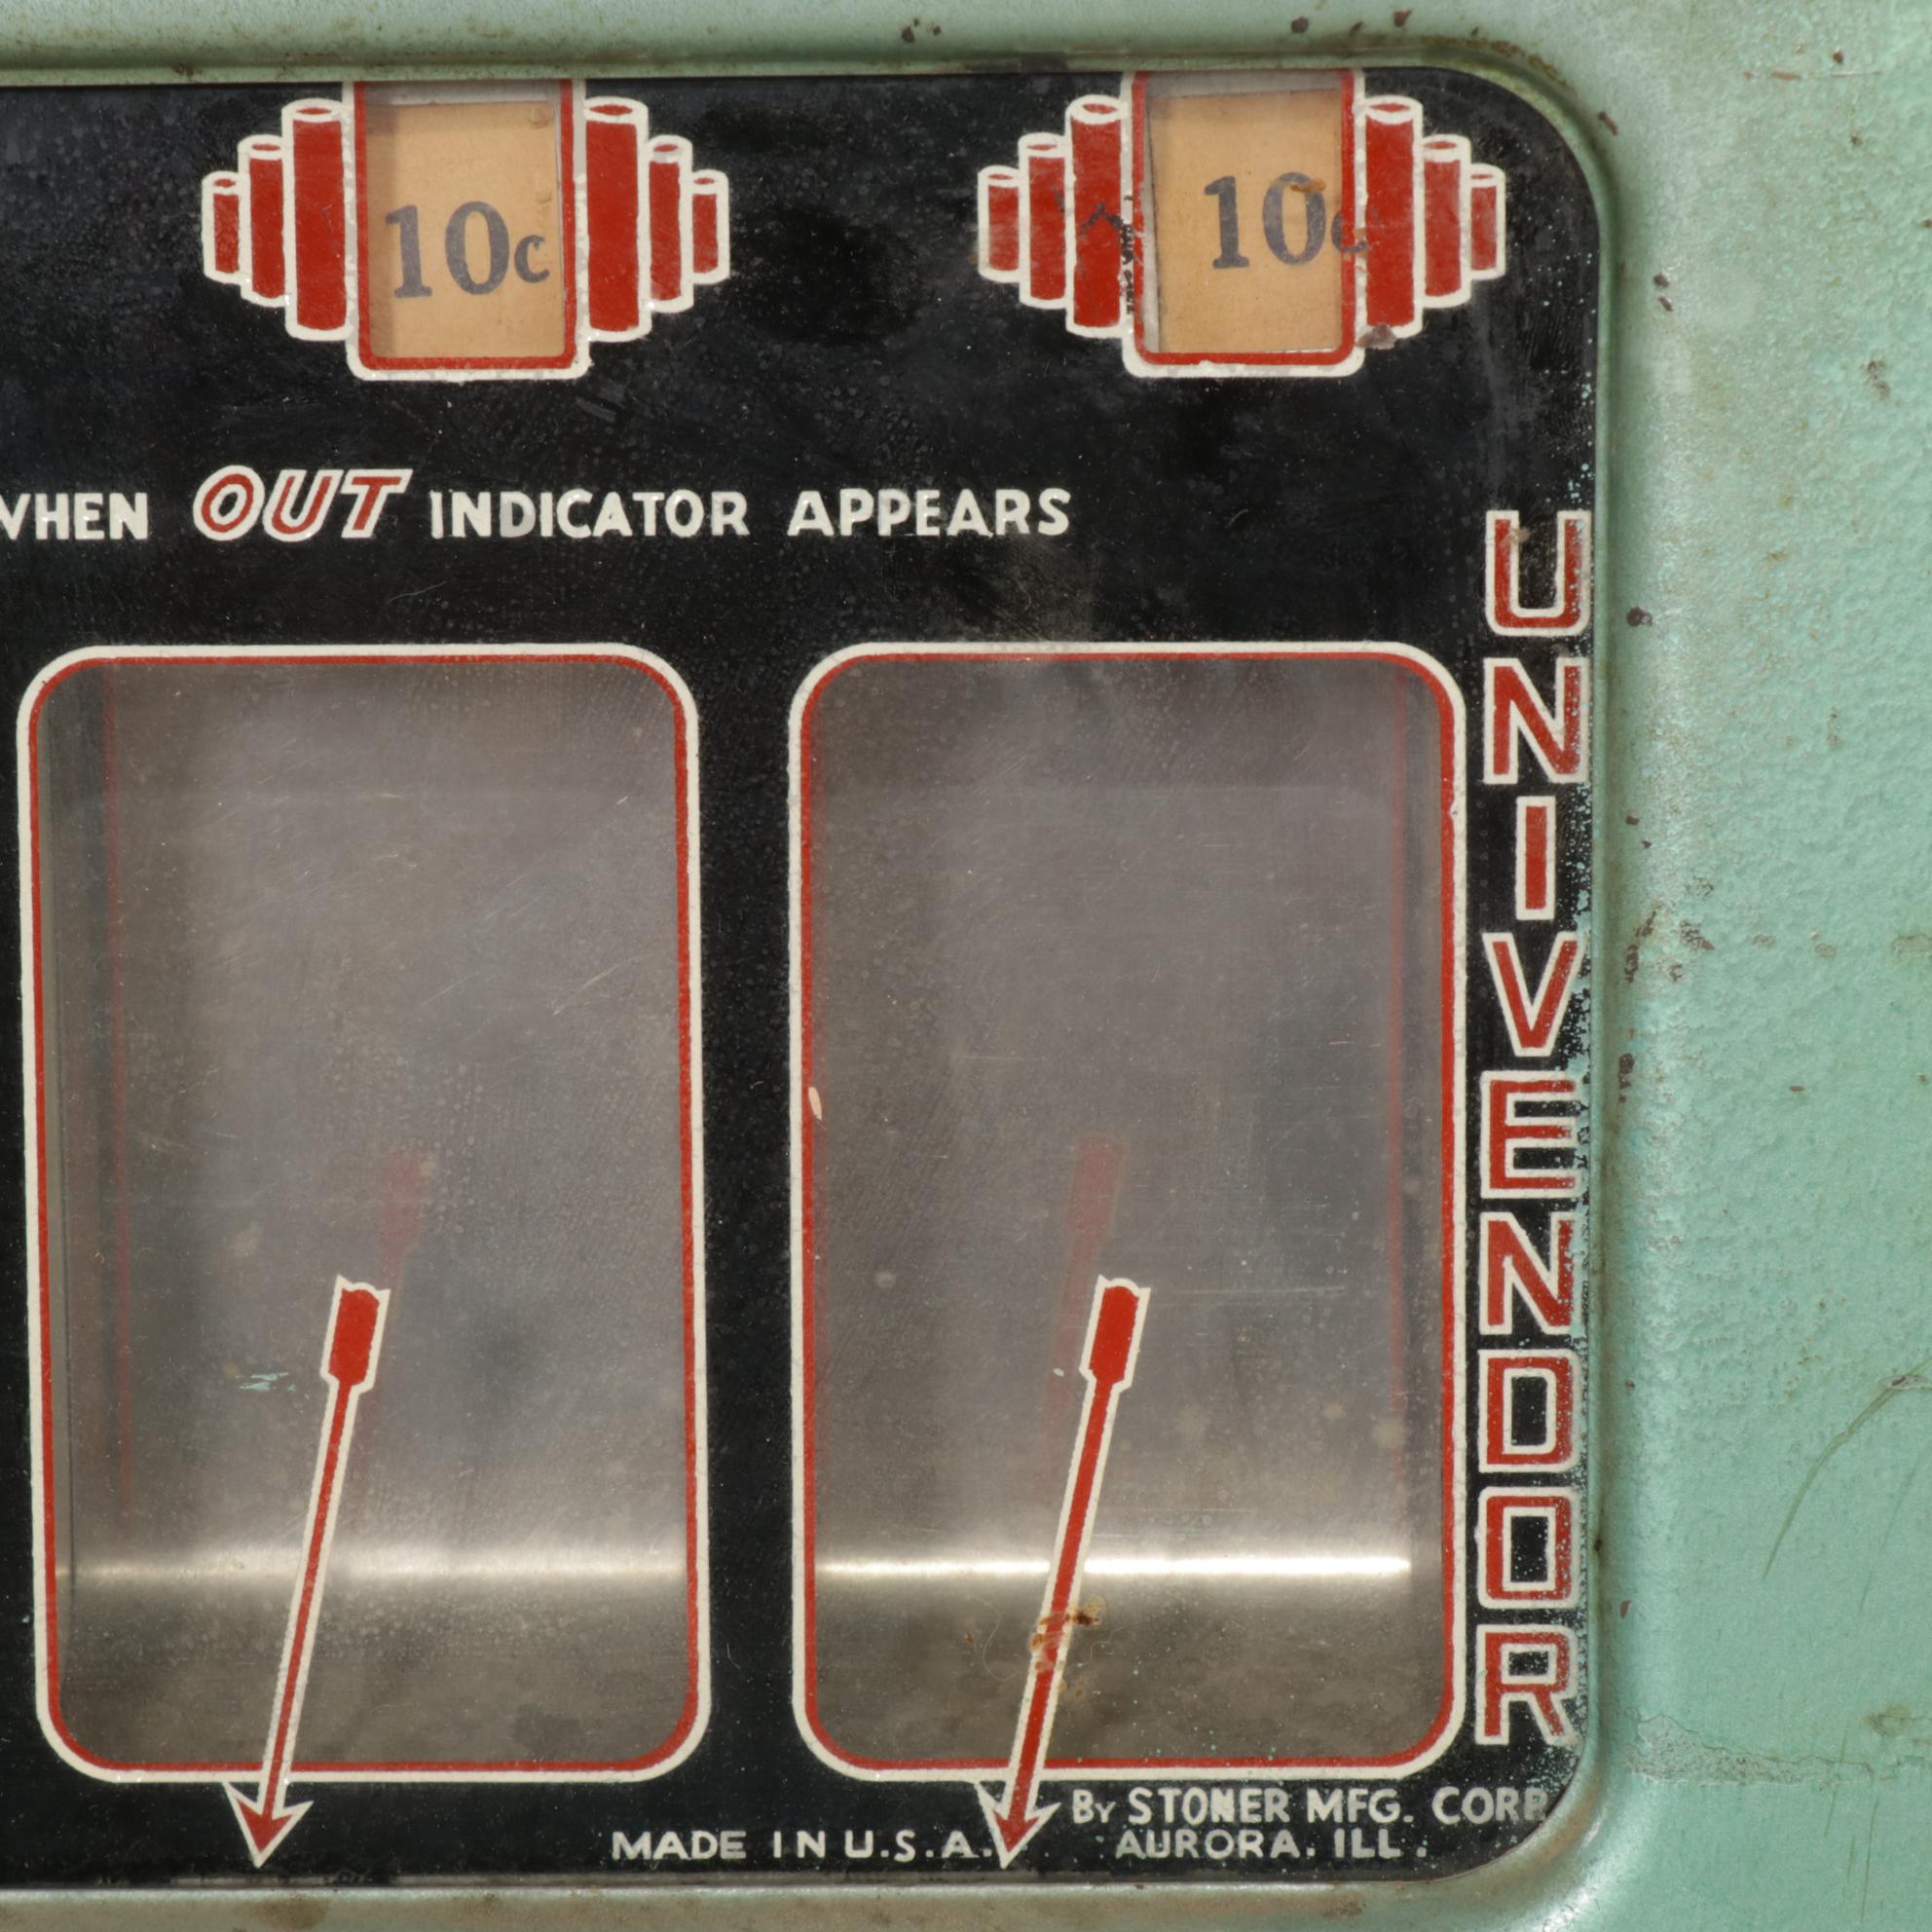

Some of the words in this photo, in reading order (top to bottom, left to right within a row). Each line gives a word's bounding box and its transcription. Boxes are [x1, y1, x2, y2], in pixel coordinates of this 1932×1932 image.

[386, 201, 550, 298] 10c
[194, 464, 414, 542] OUT
[430, 489, 750, 540] INDICATOR
[787, 488, 1072, 538] APPEARS
[1474, 509, 1591, 1747] UNIVENDOR
[1128, 1787, 1289, 1826] STONER
[1307, 1788, 1415, 1825] MFG.
[612, 1831, 747, 1861] MADE
[773, 1831, 826, 1859] IN
[845, 1831, 992, 1863] U.S.A.
